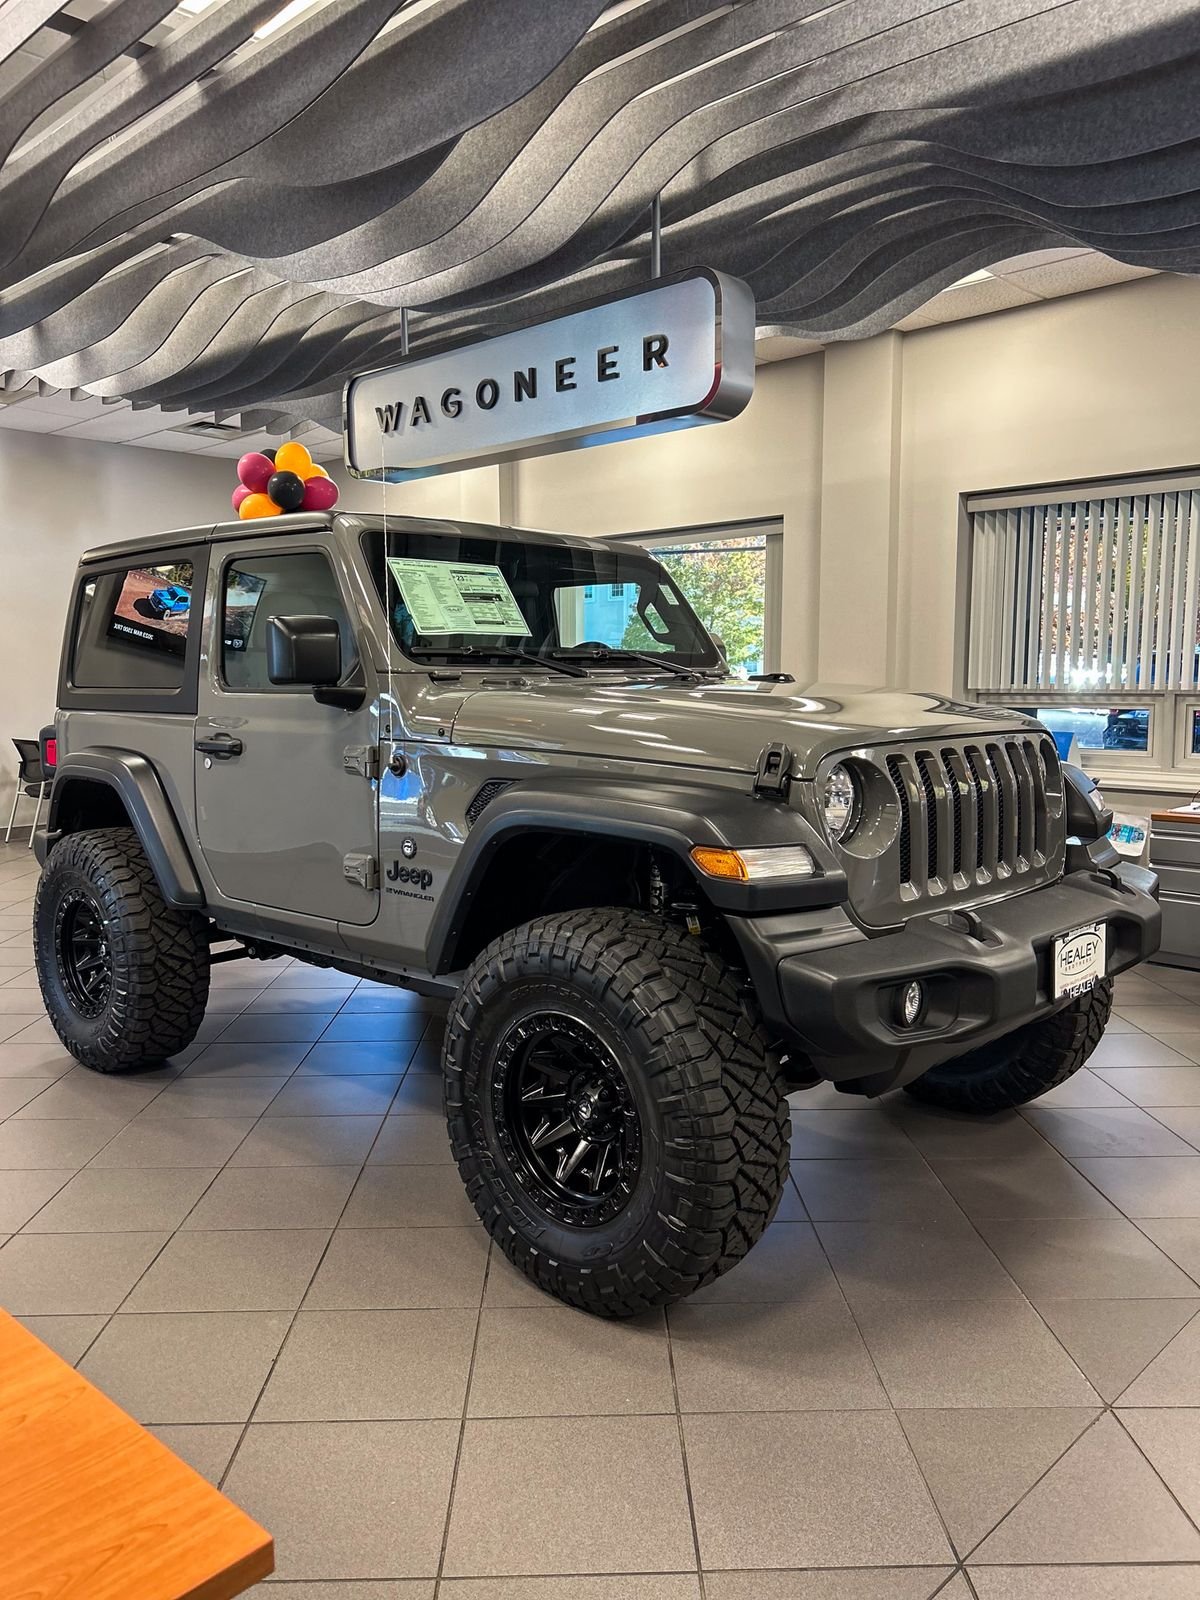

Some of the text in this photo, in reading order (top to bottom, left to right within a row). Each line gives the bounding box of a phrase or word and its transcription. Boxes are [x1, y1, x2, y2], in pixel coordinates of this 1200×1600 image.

[375, 334, 670, 433] WAGONEER
[386, 860, 433, 890] Jeep
[393, 888, 435, 902] WRANGLER
[1060, 939, 1099, 968] HEALEY
[1069, 977, 1096, 998] HEALEY
